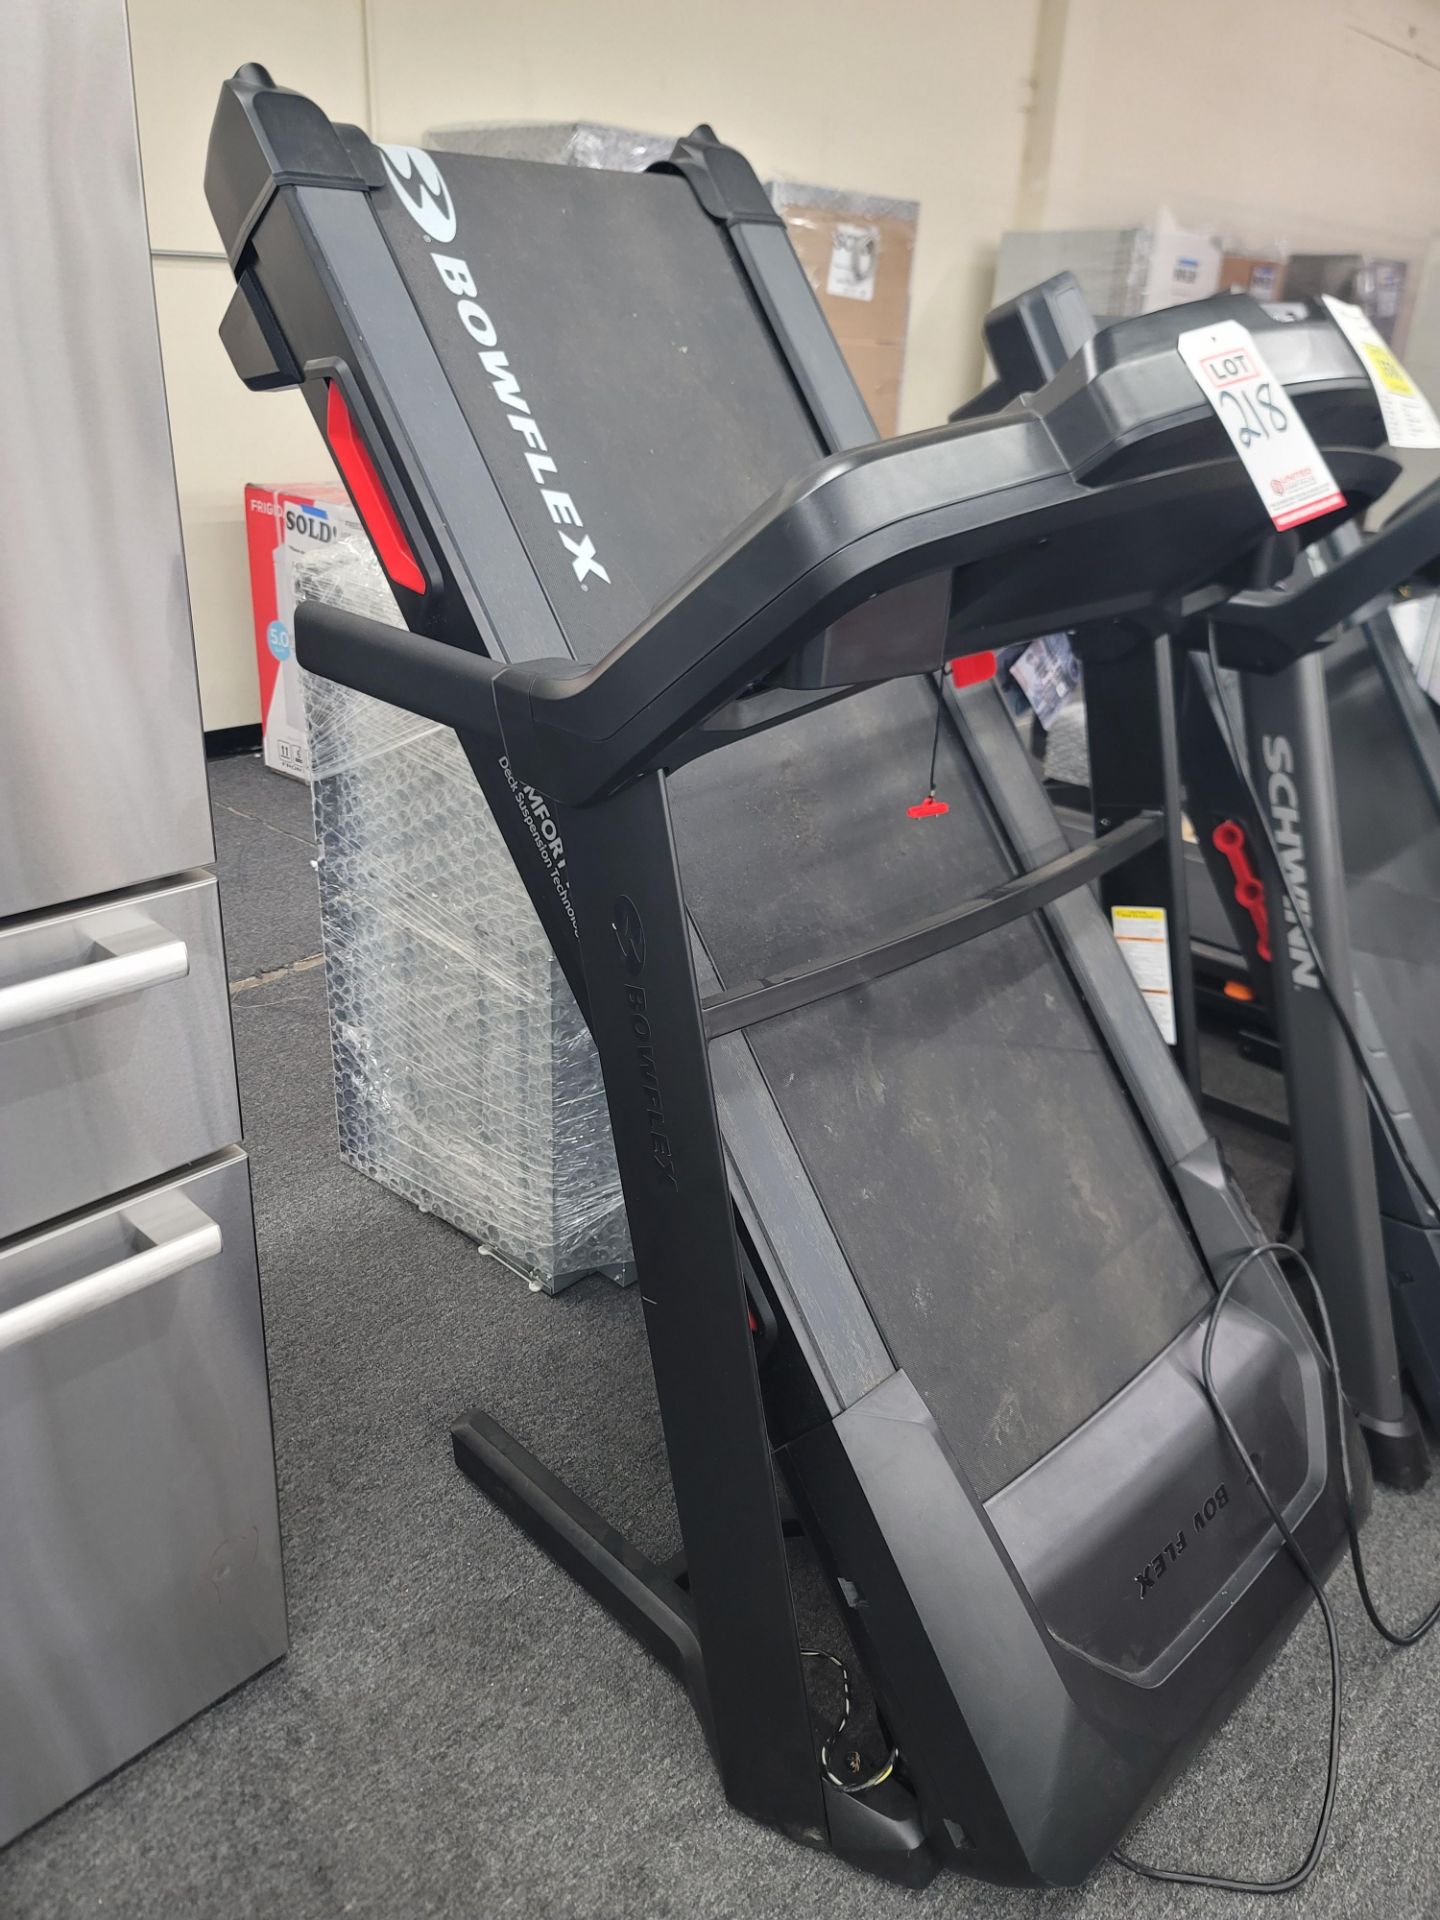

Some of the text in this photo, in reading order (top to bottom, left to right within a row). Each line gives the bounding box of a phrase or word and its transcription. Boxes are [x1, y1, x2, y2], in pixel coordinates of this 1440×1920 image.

[1208, 355, 1249, 380] LOT
[430, 252, 610, 585] BOWFLEX
[1219, 382, 1288, 448] 218
[250, 499, 284, 518] FRIGID
[269, 628, 289, 648] 5.0
[498, 756, 580, 940] Deck Suspension Techno
